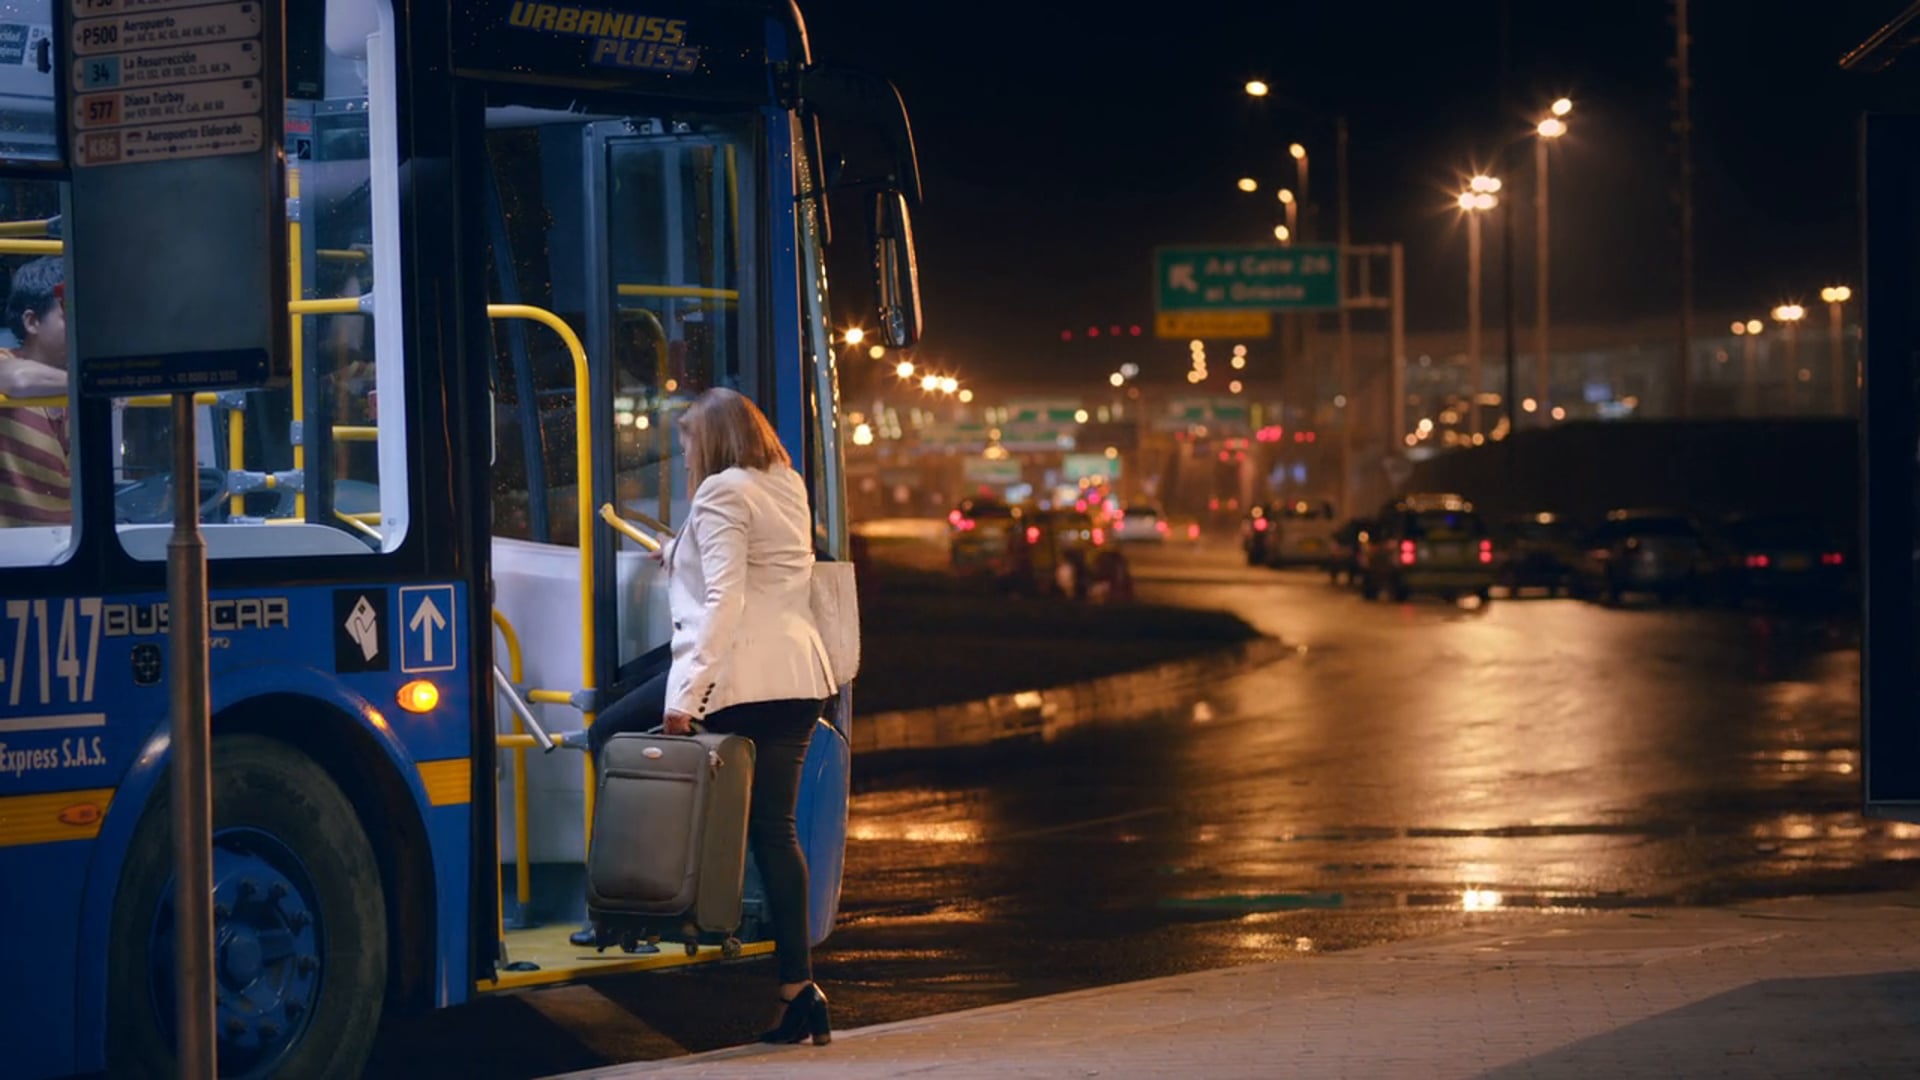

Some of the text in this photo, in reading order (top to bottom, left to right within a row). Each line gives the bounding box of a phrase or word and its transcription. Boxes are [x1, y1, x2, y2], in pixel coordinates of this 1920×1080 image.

[124, 17, 175, 32] Aeropuerto
[509, 1, 687, 44] URBANUSS
[83, 26, 117, 46] P500
[124, 51, 196, 69] La Resurrección
[592, 38, 700, 71] PLUSS
[92, 63, 109, 82] 34
[124, 91, 184, 107] Diana Turbay
[90, 100, 113, 120] 577
[146, 122, 242, 142] Aeropuerto Eldorado
[89, 136, 117, 157] K86
[104, 598, 288, 636] BUCAR
[0, 736, 106, 778] Express S.A.S.
